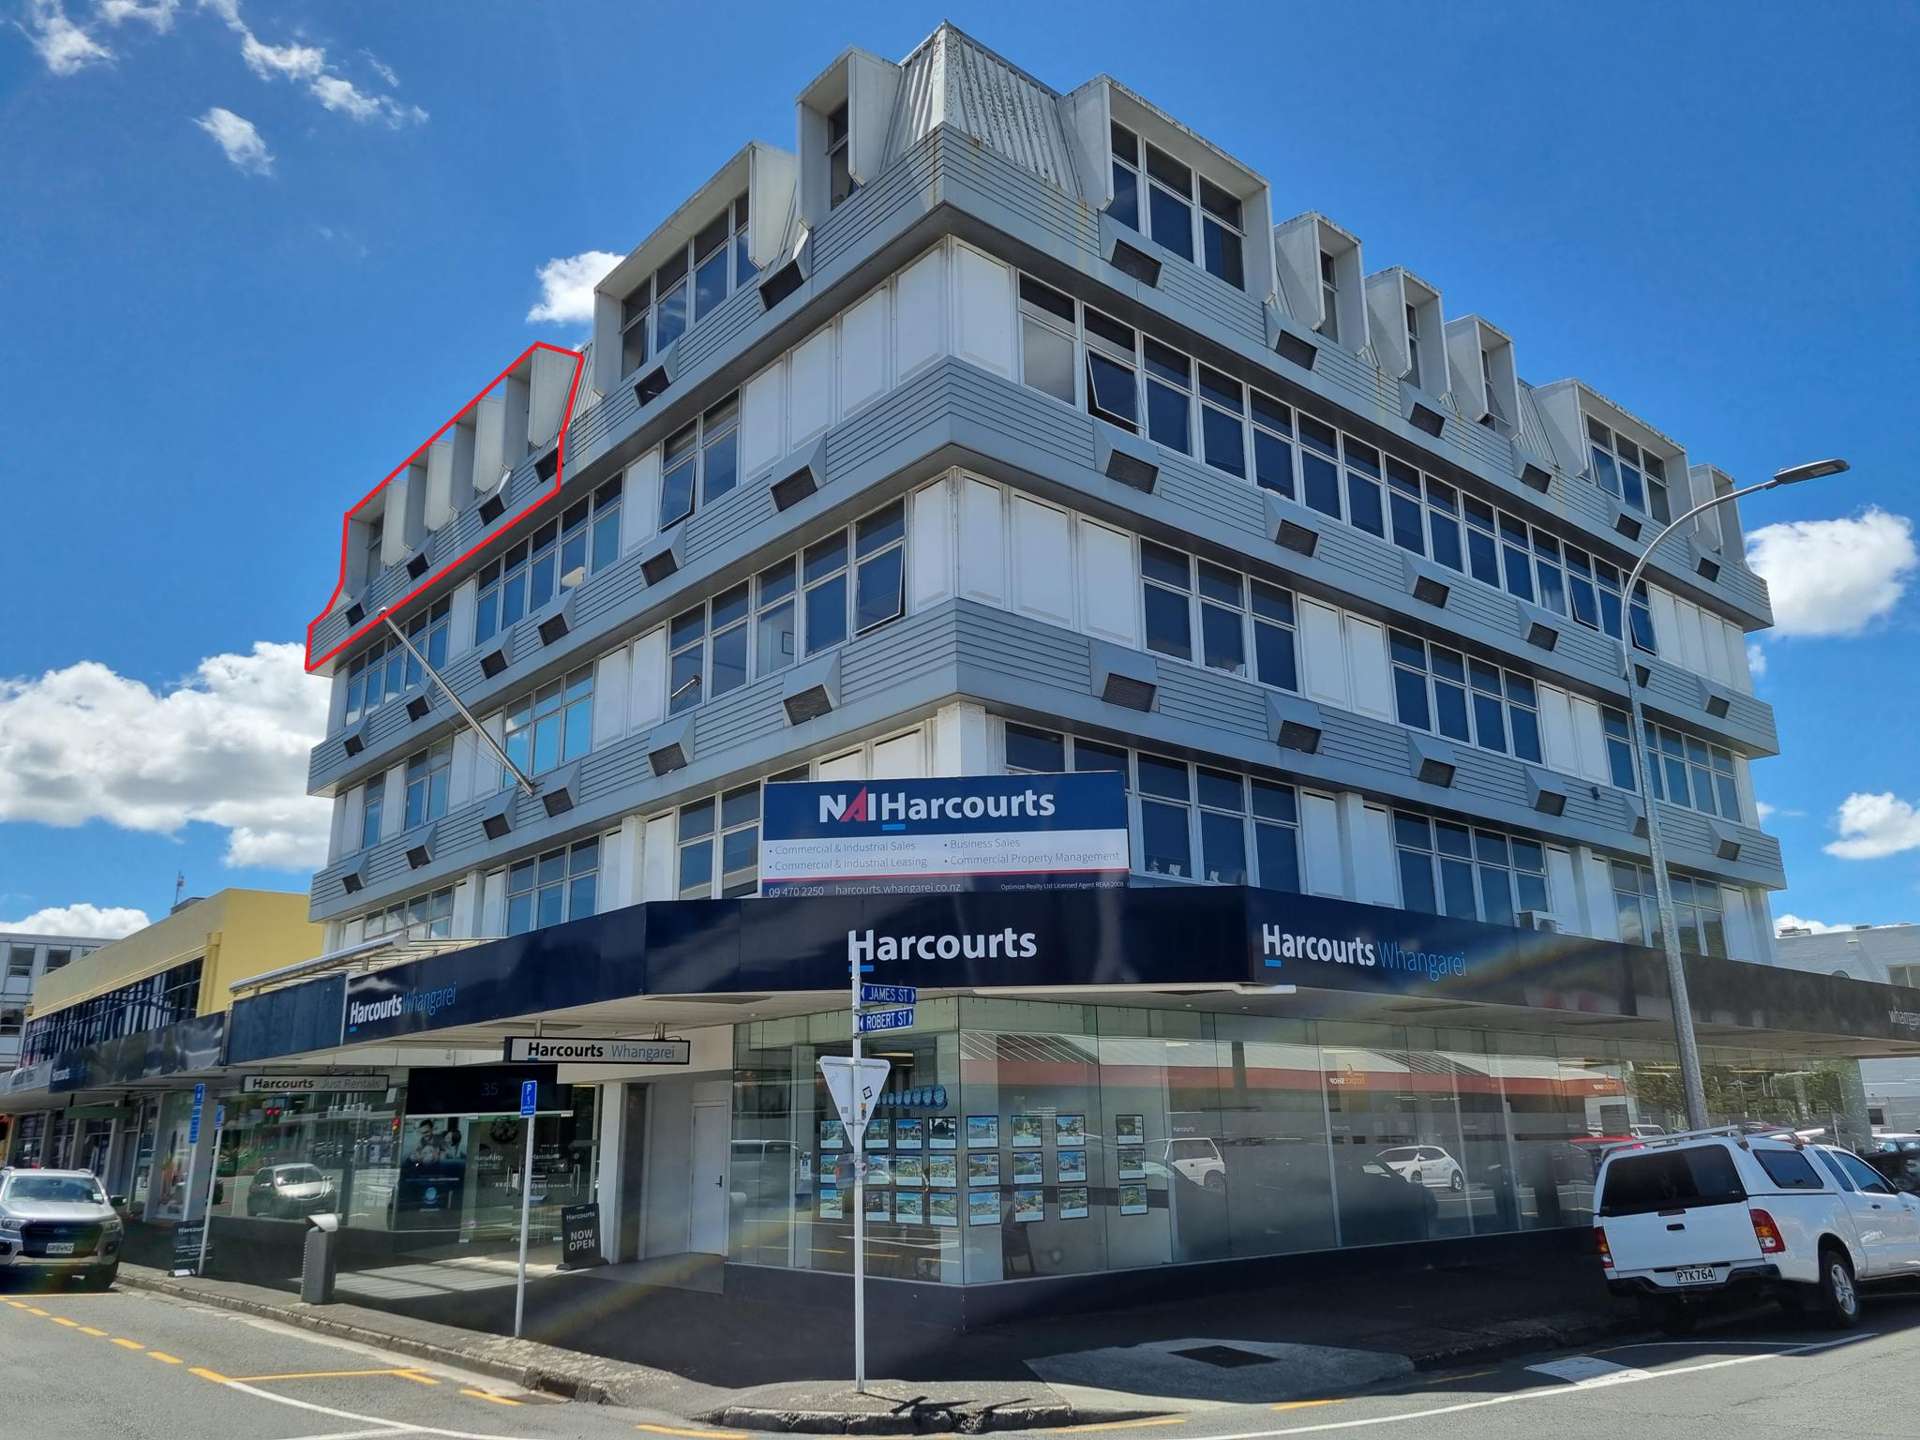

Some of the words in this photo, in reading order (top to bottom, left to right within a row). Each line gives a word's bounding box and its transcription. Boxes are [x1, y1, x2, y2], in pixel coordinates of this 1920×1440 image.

[881, 789, 1056, 821] Harcourts
[775, 843, 832, 855] Commercial
[833, 843, 841, 853] &
[844, 841, 888, 852] Industrial
[891, 840, 916, 851] Sales
[950, 838, 992, 849] Business
[995, 837, 1020, 848] Sales
[775, 859, 832, 871] Commercial
[833, 858, 841, 869] &
[844, 857, 888, 868] Industrial
[891, 857, 928, 869] Leasing
[950, 854, 1008, 865] Commercial
[1011, 853, 1053, 865] Property
[1056, 851, 1119, 863] Management
[769, 887, 780, 897] 09
[783, 887, 800, 897] 470
[802, 886, 824, 896] 2250
[848, 927, 1037, 961] Harcourts
[1263, 923, 1375, 967] Harcourts
[1377, 940, 1467, 982] Whangarei
[869, 987, 895, 1001] JAMES
[898, 988, 908, 1002] ST
[349, 994, 402, 1024] Harcourts
[402, 981, 457, 1016] Whangarei
[867, 1012, 895, 1030] ROBERT
[898, 1011, 907, 1026] ST
[528, 1042, 603, 1057] Harcourts
[611, 1043, 675, 1061] Whangarei
[253, 1078, 314, 1089] Harcourts
[481, 1083, 499, 1096] 35
[566, 1211, 595, 1221] Harcourts
[570, 1229, 593, 1240] NOW
[569, 1239, 595, 1251] OPEN
[1677, 1267, 1714, 1281] PTK764
